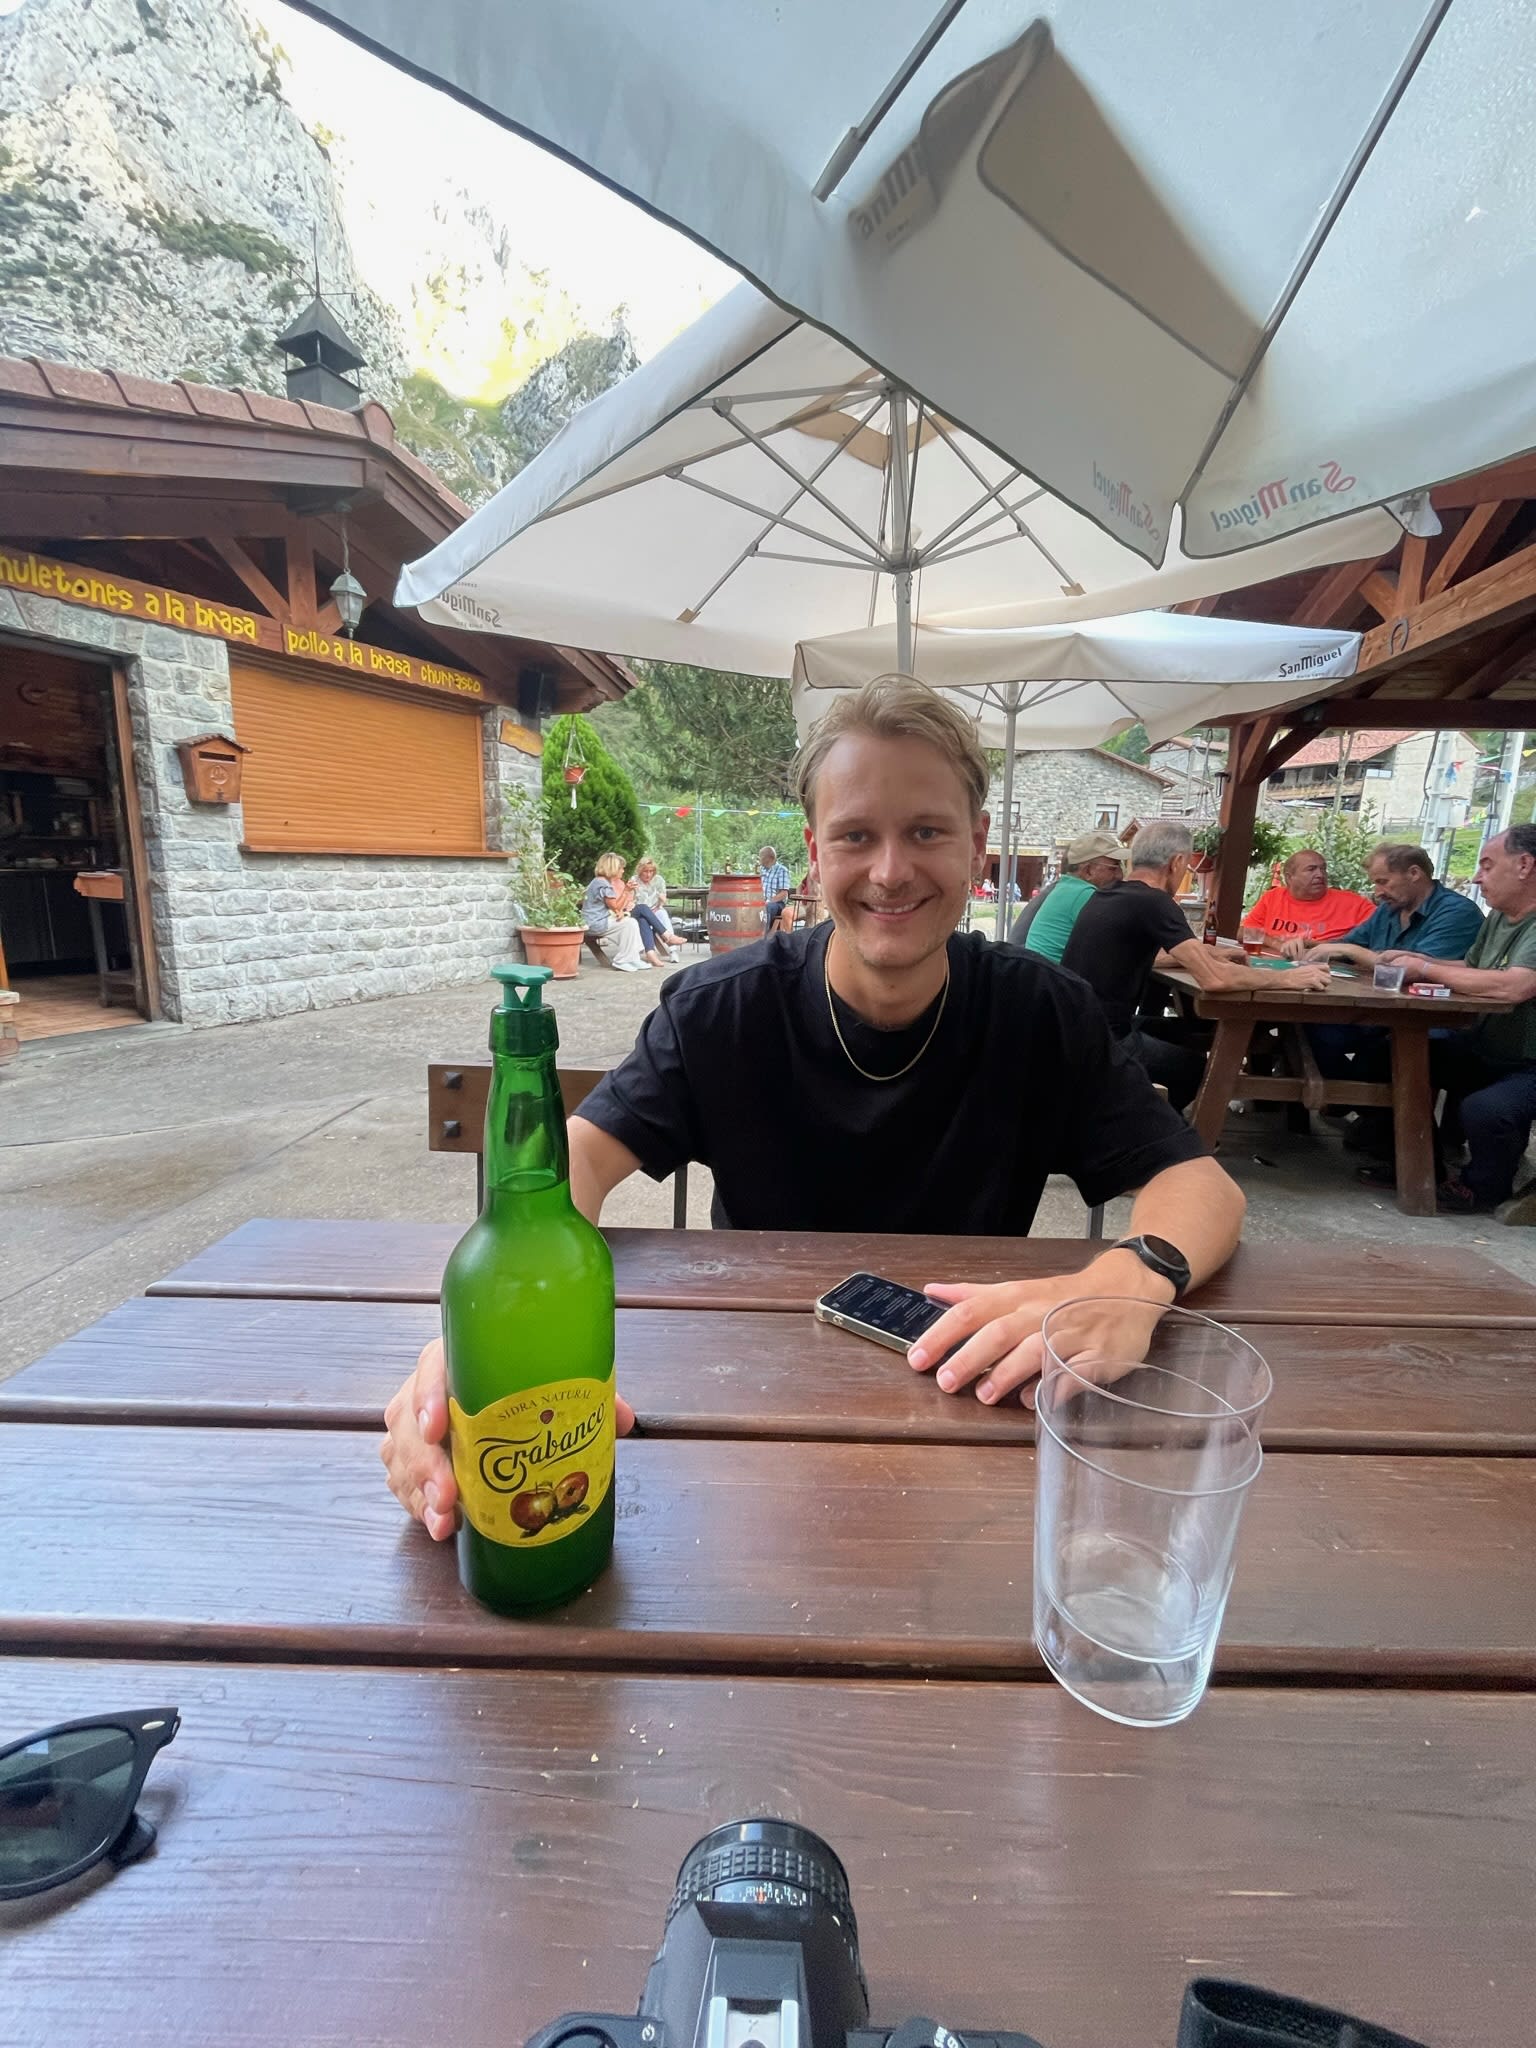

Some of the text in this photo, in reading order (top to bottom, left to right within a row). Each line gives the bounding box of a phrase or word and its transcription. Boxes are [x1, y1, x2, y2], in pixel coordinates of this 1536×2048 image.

[144, 592, 160, 616] a
[164, 592, 185, 624] la
[195, 601, 256, 639] brasa
[287, 630, 481, 692] pollo a la brasa churrasco
[1278, 647, 1342, 678] SanMiguel
[497, 1388, 592, 1421] SIDRA NATURAL
[474, 1398, 608, 1494] Trabanco
